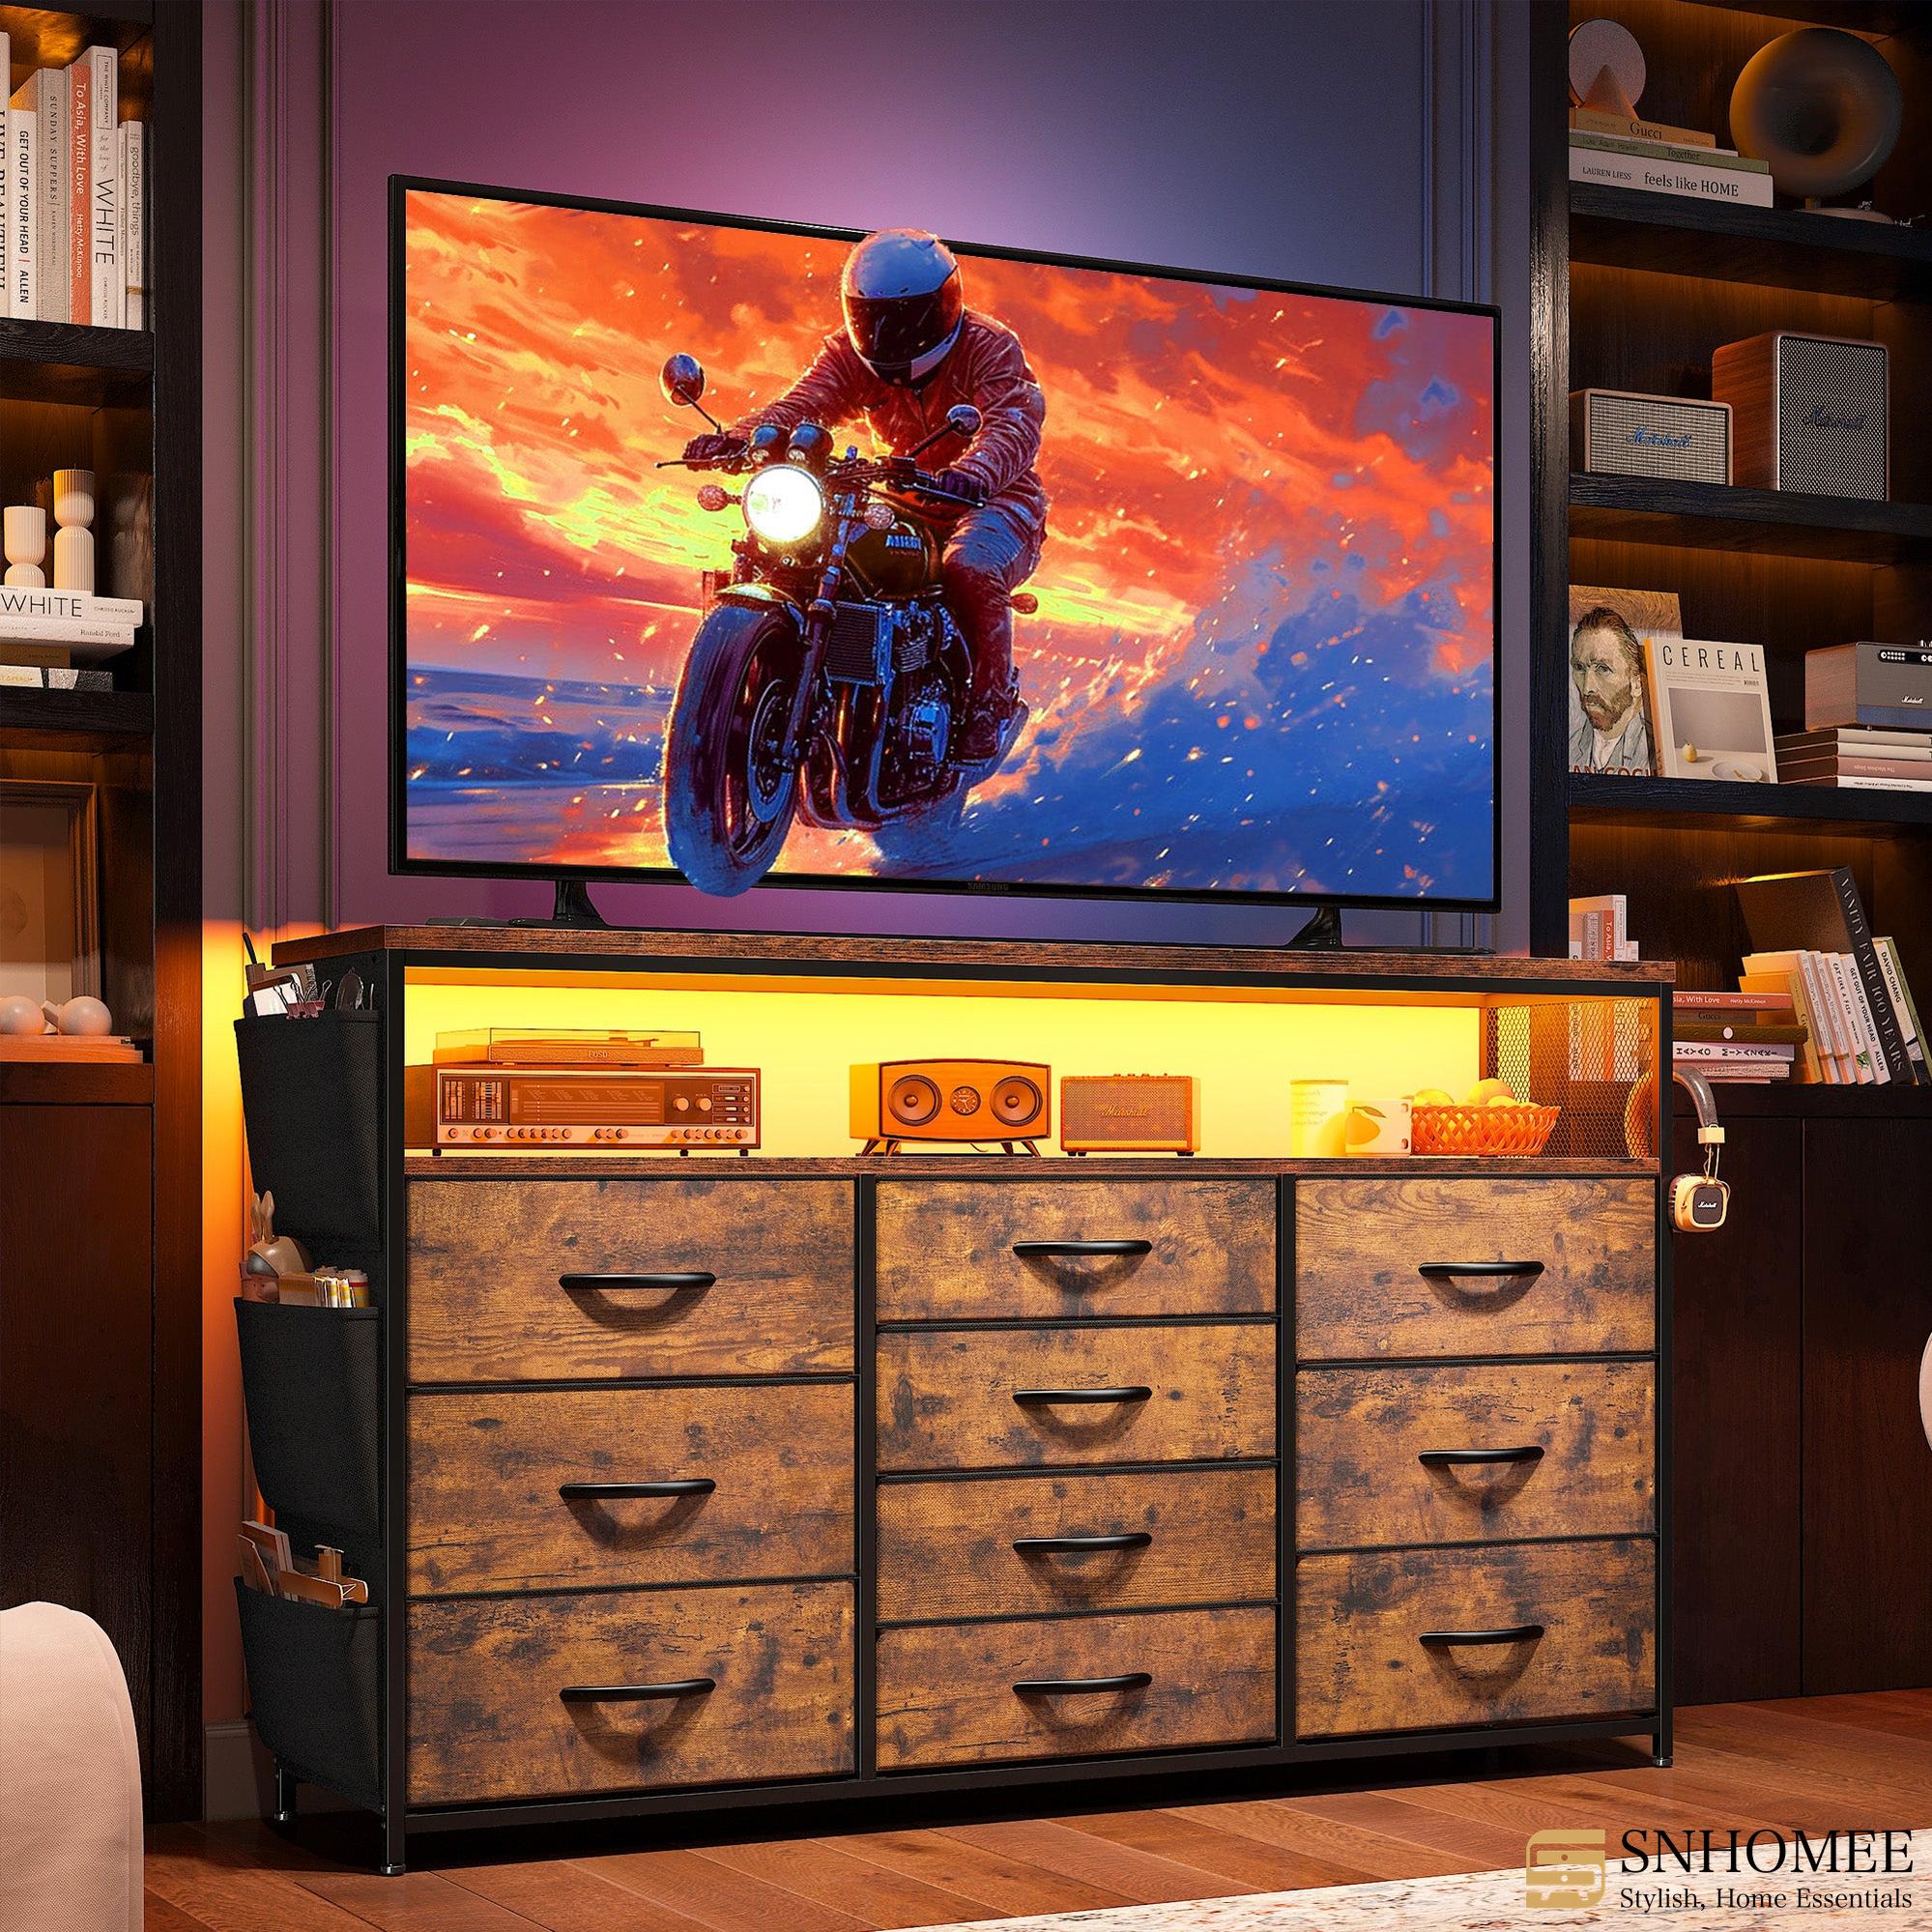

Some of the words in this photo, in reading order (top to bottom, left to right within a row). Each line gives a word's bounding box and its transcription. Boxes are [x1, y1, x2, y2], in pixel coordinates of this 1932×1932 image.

[76, 83, 87, 98] To
[74, 101, 86, 130] Asia,
[19, 130, 29, 151] GET
[1629, 121, 1662, 140] Gucci
[76, 133, 87, 163] With
[19, 153, 29, 173] OUT
[49, 148, 58, 201] SUPPERS
[130, 147, 140, 199] goodbye,
[1582, 166, 1611, 177] LAUREN
[1612, 169, 1631, 181] LIESS
[19, 177, 29, 190] OF
[76, 166, 86, 194] Love
[1644, 172, 1672, 187] feels
[1675, 176, 1697, 191] like
[1701, 180, 1739, 197] HOME
[19, 194, 29, 221] YOUR
[130, 202, 142, 236] things
[75, 214, 84, 236] Hetty
[96, 178, 115, 264] WHITE
[19, 225, 29, 253] HEAD
[75, 239, 84, 278] McKinnon
[19, 270, 29, 303] ALLEN
[1, 593, 82, 618] WHITE
[1662, 646, 1760, 673] CEREAL
[1840, 877, 1864, 936] VANITY
[1859, 942, 1878, 981] FAIR
[1871, 986, 1888, 1014] 100
[1881, 1011, 1904, 1073] YEARS
[1881, 952, 1892, 976] DAVID
[1889, 976, 1902, 1004] CHANG
[1858, 995, 1864, 1004] OF
[1860, 1002, 1869, 1023] YOUR
[1865, 1022, 1876, 1042] HEAD
[1676, 1047, 1711, 1055] HAYAO
[1721, 1048, 1778, 1057] MIYAZAKI
[1875, 1051, 1885, 1072] ALLEN
